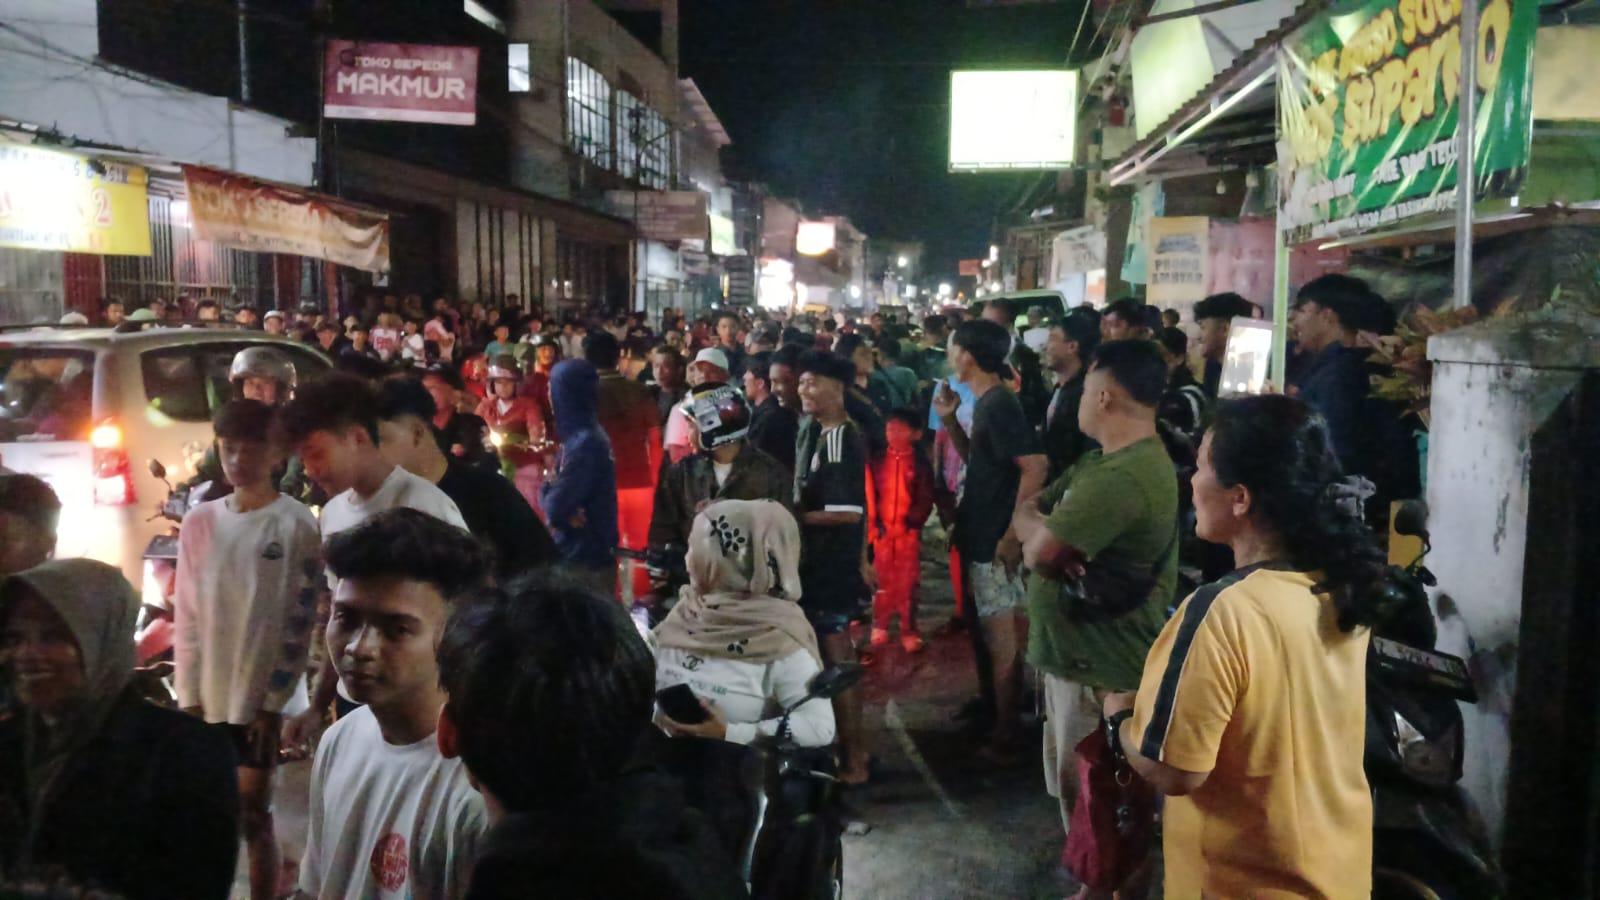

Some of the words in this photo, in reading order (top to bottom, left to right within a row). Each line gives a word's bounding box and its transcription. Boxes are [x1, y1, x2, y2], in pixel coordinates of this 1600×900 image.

[393, 58, 453, 71] SEPEDA
[336, 71, 466, 100] MAKMUR
[92, 188, 112, 225] 2
